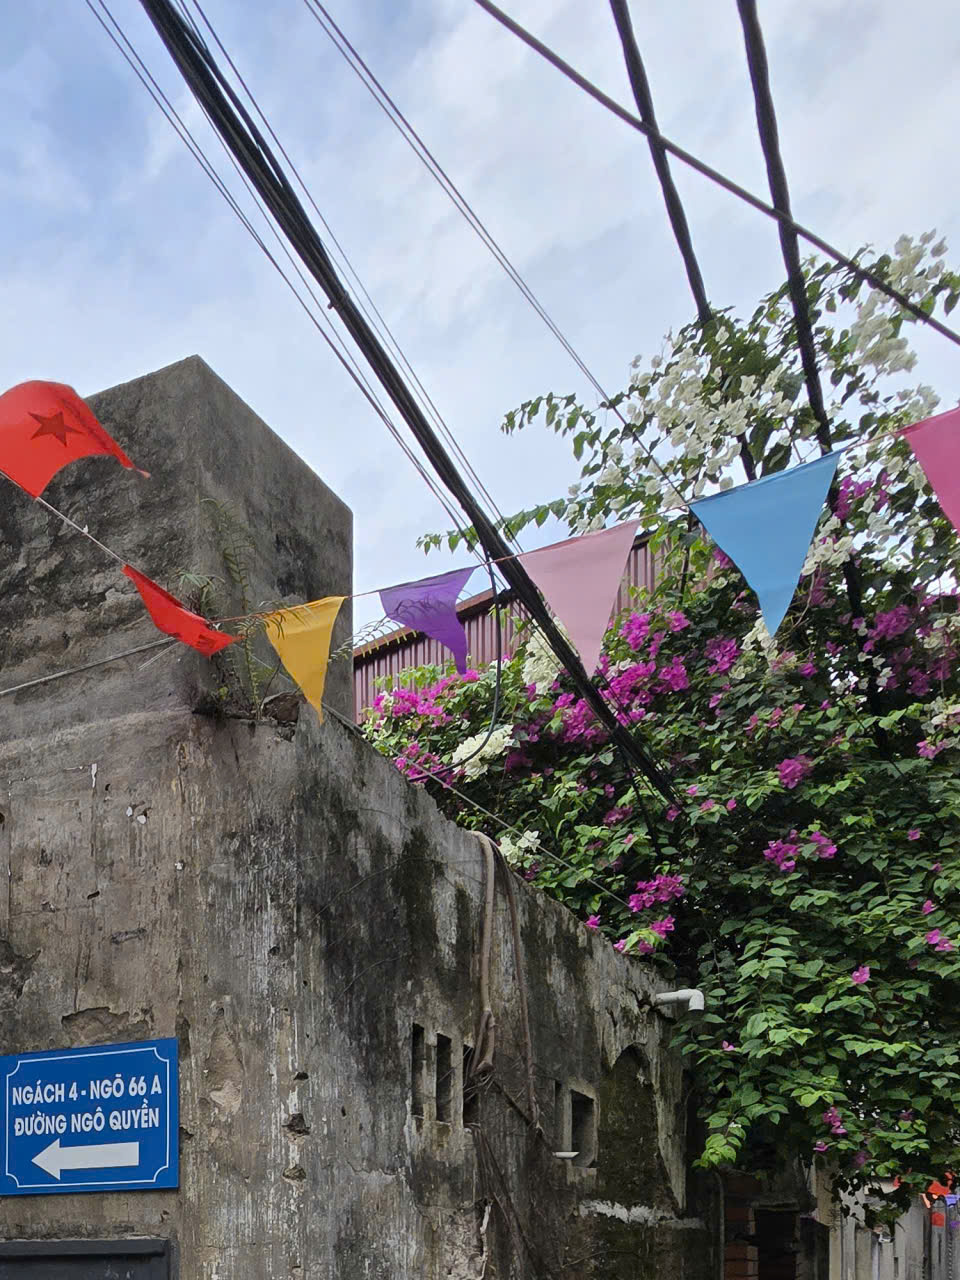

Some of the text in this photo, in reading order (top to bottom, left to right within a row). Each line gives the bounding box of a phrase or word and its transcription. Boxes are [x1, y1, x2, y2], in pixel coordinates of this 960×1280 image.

[12, 1079, 65, 1106] NGÁCH
[68, 1081, 78, 1101] 4
[90, 1073, 125, 1100] NGÕ
[128, 1076, 147, 1097] 66
[150, 1074, 162, 1096] A
[14, 1098, 160, 1137] ĐƯỜNG NGÔ QUYỀN
